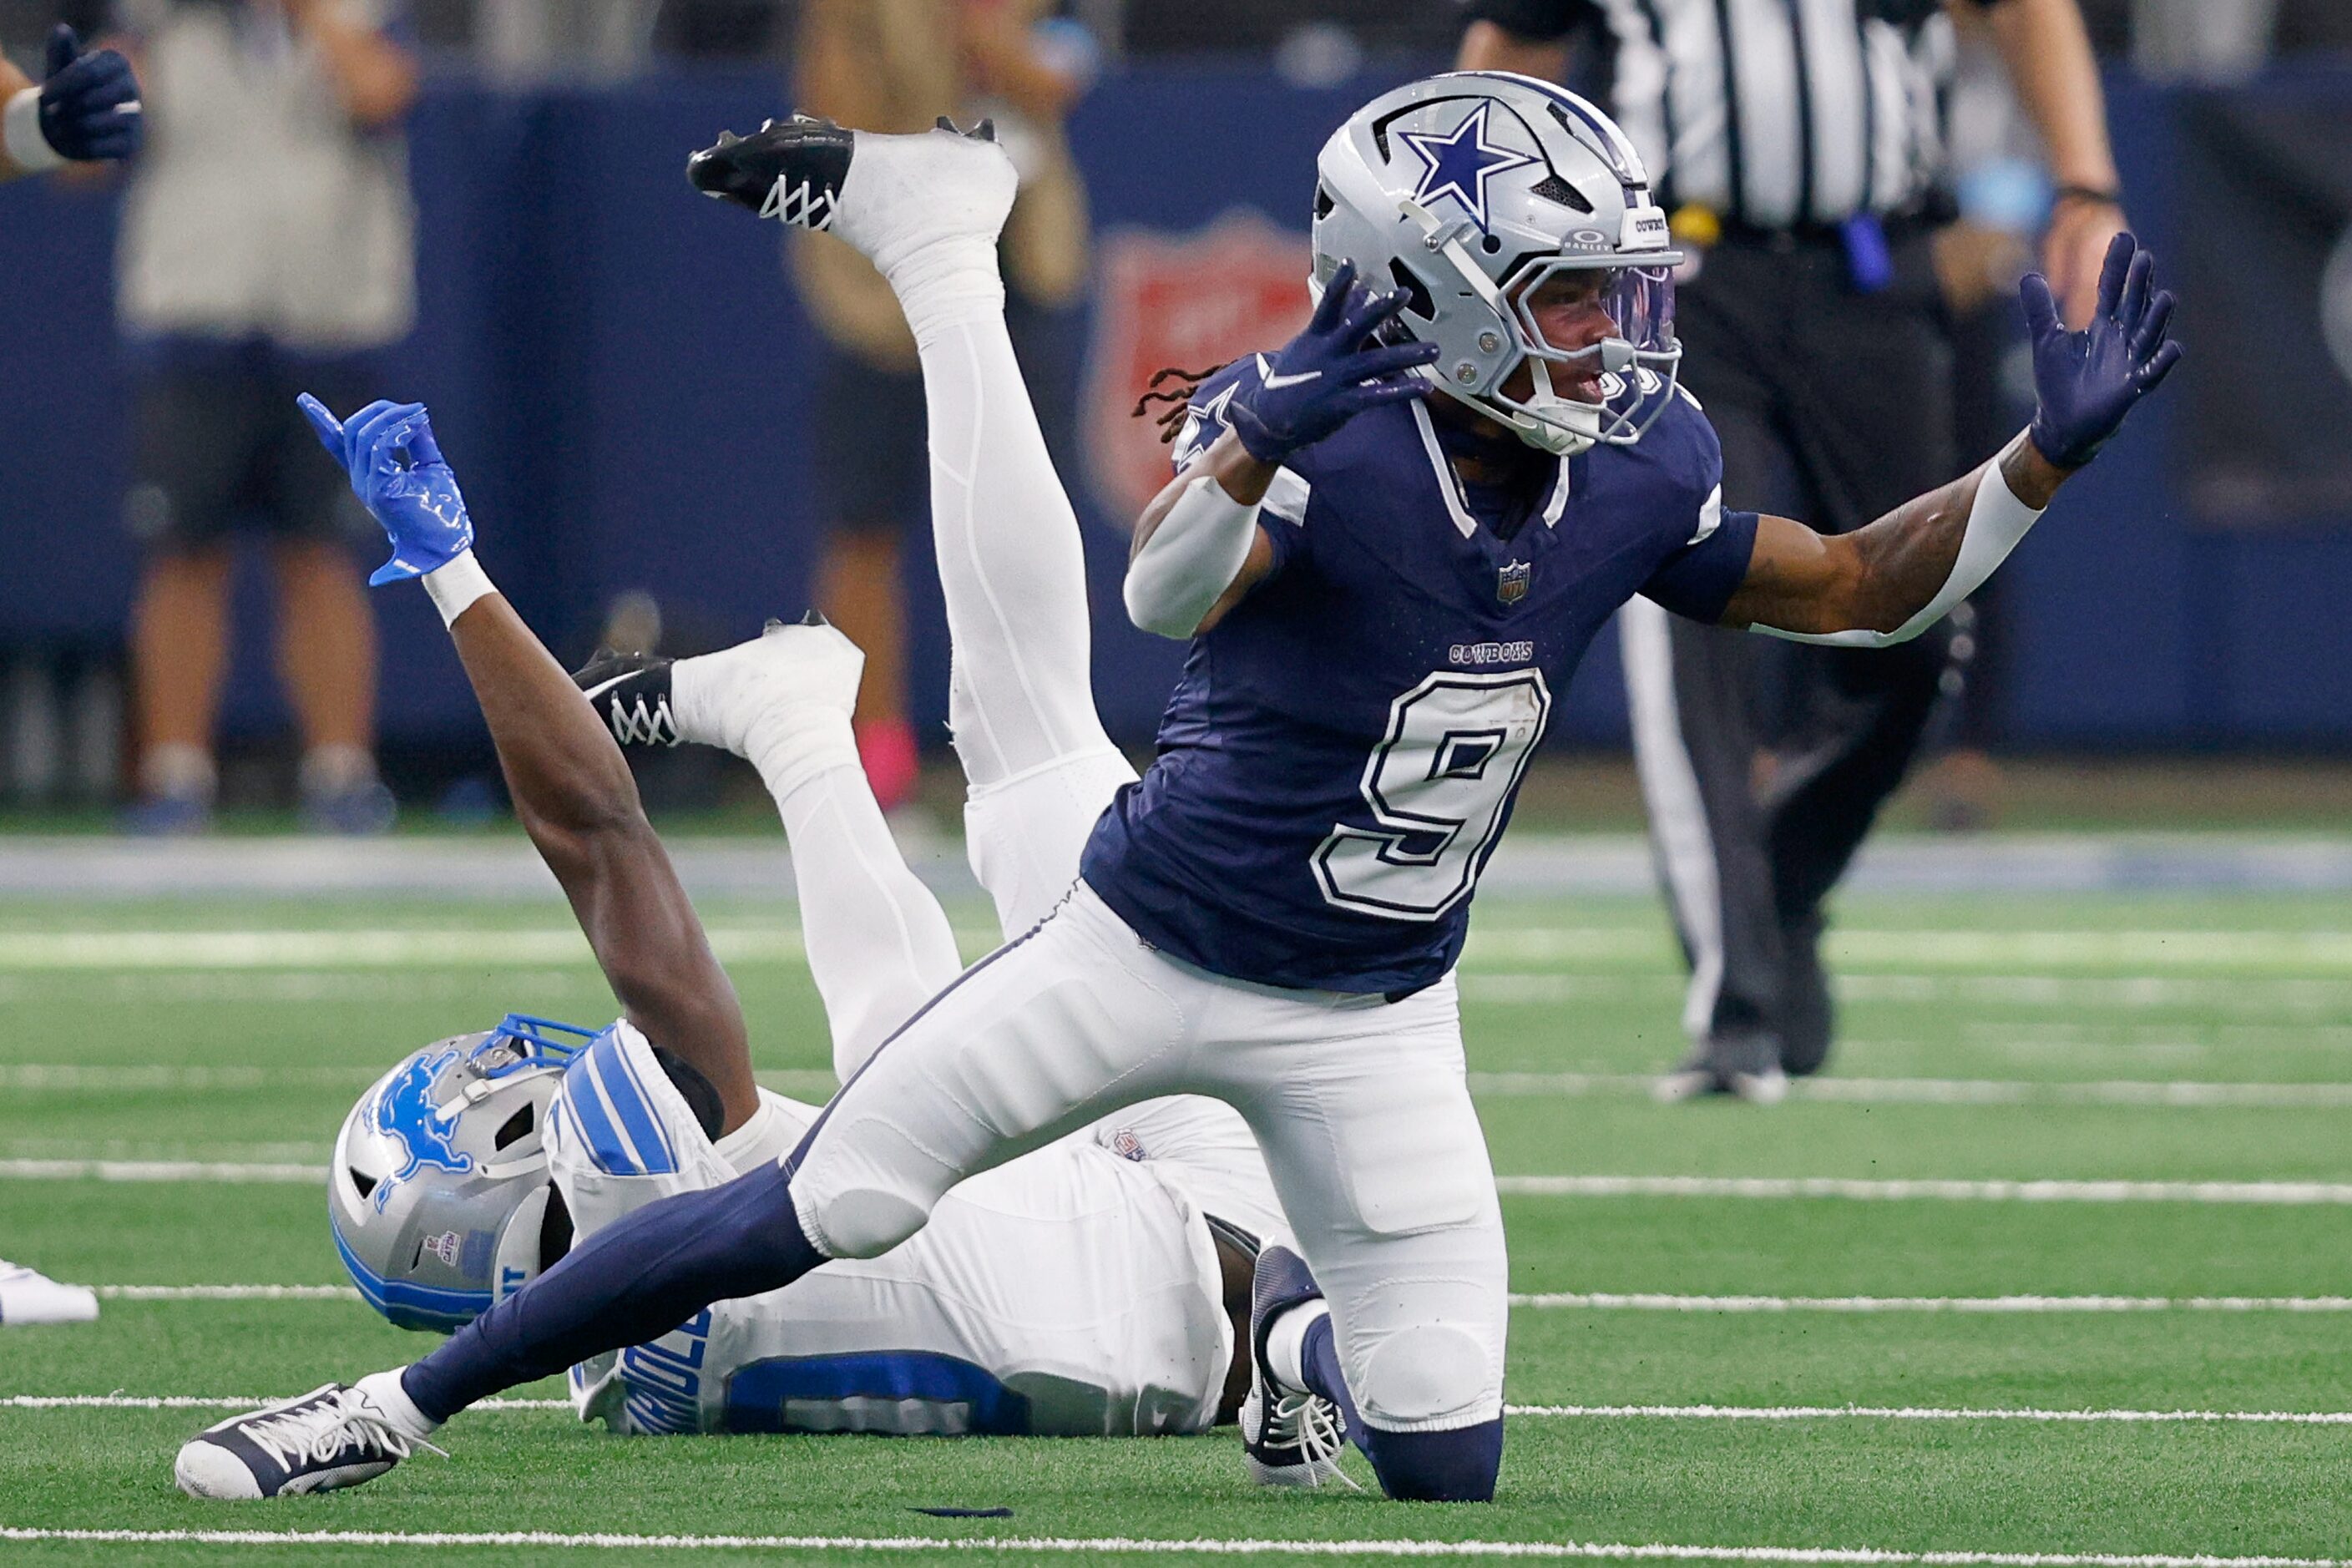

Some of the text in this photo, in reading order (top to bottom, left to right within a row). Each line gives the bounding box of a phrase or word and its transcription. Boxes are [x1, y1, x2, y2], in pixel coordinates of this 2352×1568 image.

[1564, 242, 1610, 251] OAKLEY
[1449, 641, 1534, 664] COWBOYS
[1308, 666, 1551, 922] 9
